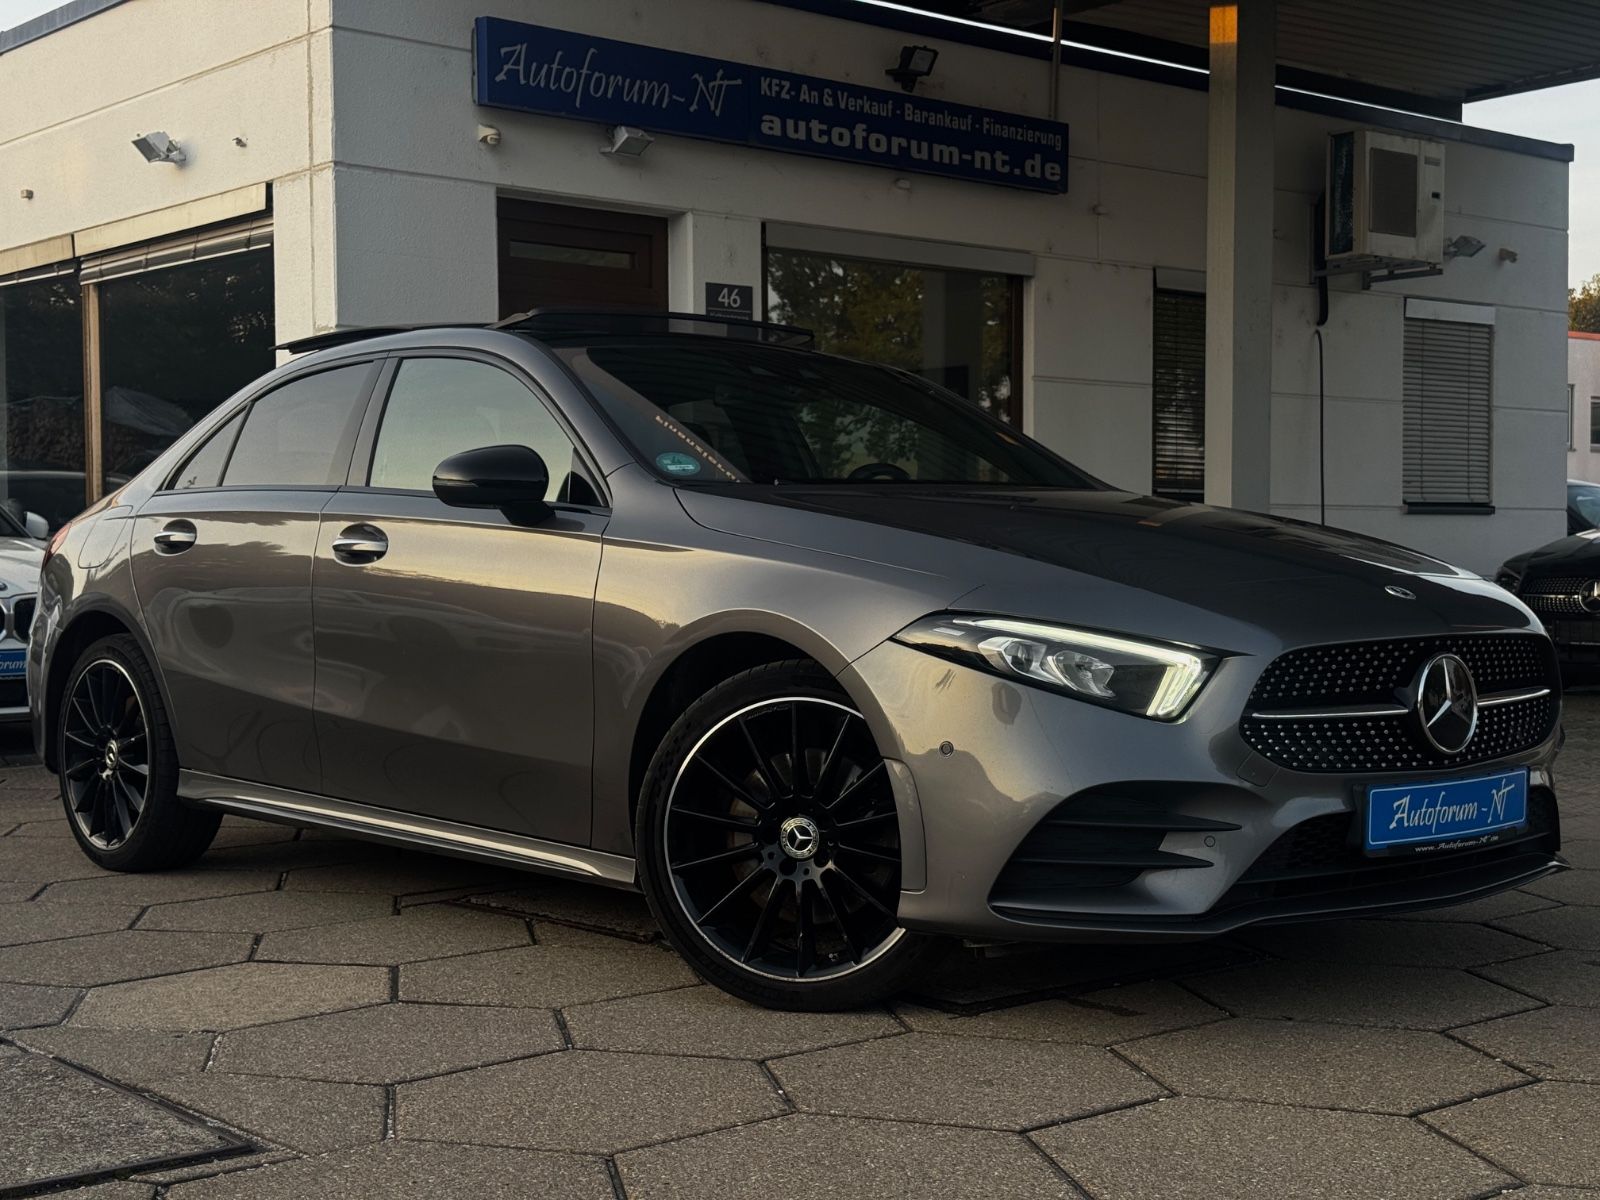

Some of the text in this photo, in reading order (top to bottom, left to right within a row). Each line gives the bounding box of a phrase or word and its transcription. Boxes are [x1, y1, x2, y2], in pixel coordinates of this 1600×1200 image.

[760, 113, 1062, 182] autoforum-nt.de
[799, 83, 819, 105] An
[822, 87, 834, 107] &
[837, 90, 893, 118] Verkauf
[903, 103, 973, 132] Barankauf
[982, 117, 1062, 151] Finanzierung
[718, 287, 741, 308] 46
